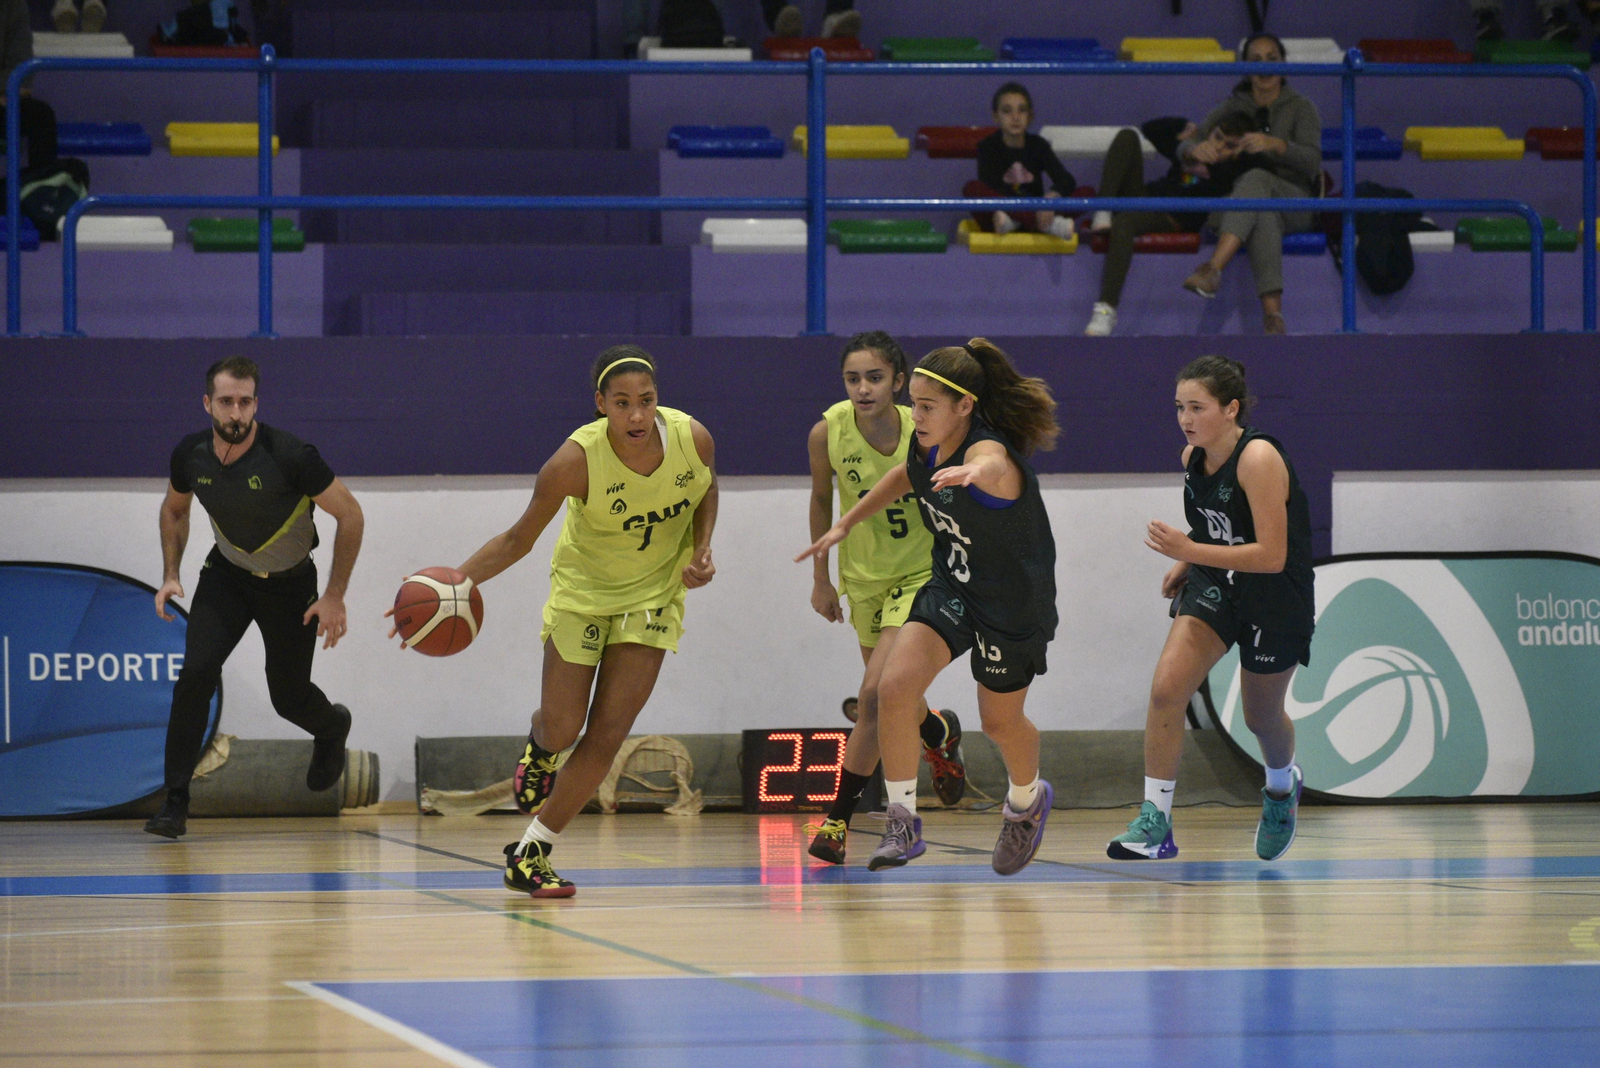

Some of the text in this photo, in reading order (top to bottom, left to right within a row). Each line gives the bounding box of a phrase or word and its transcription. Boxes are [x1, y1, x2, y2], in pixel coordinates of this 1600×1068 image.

[842, 454, 863, 465] vive
[606, 482, 626, 495] vive
[886, 508, 909, 539] 5
[645, 621, 669, 634] vive
[1255, 653, 1276, 663] vive
[28, 652, 185, 681] DEPORTE
[985, 665, 1008, 674] vive
[759, 733, 847, 801] 23
